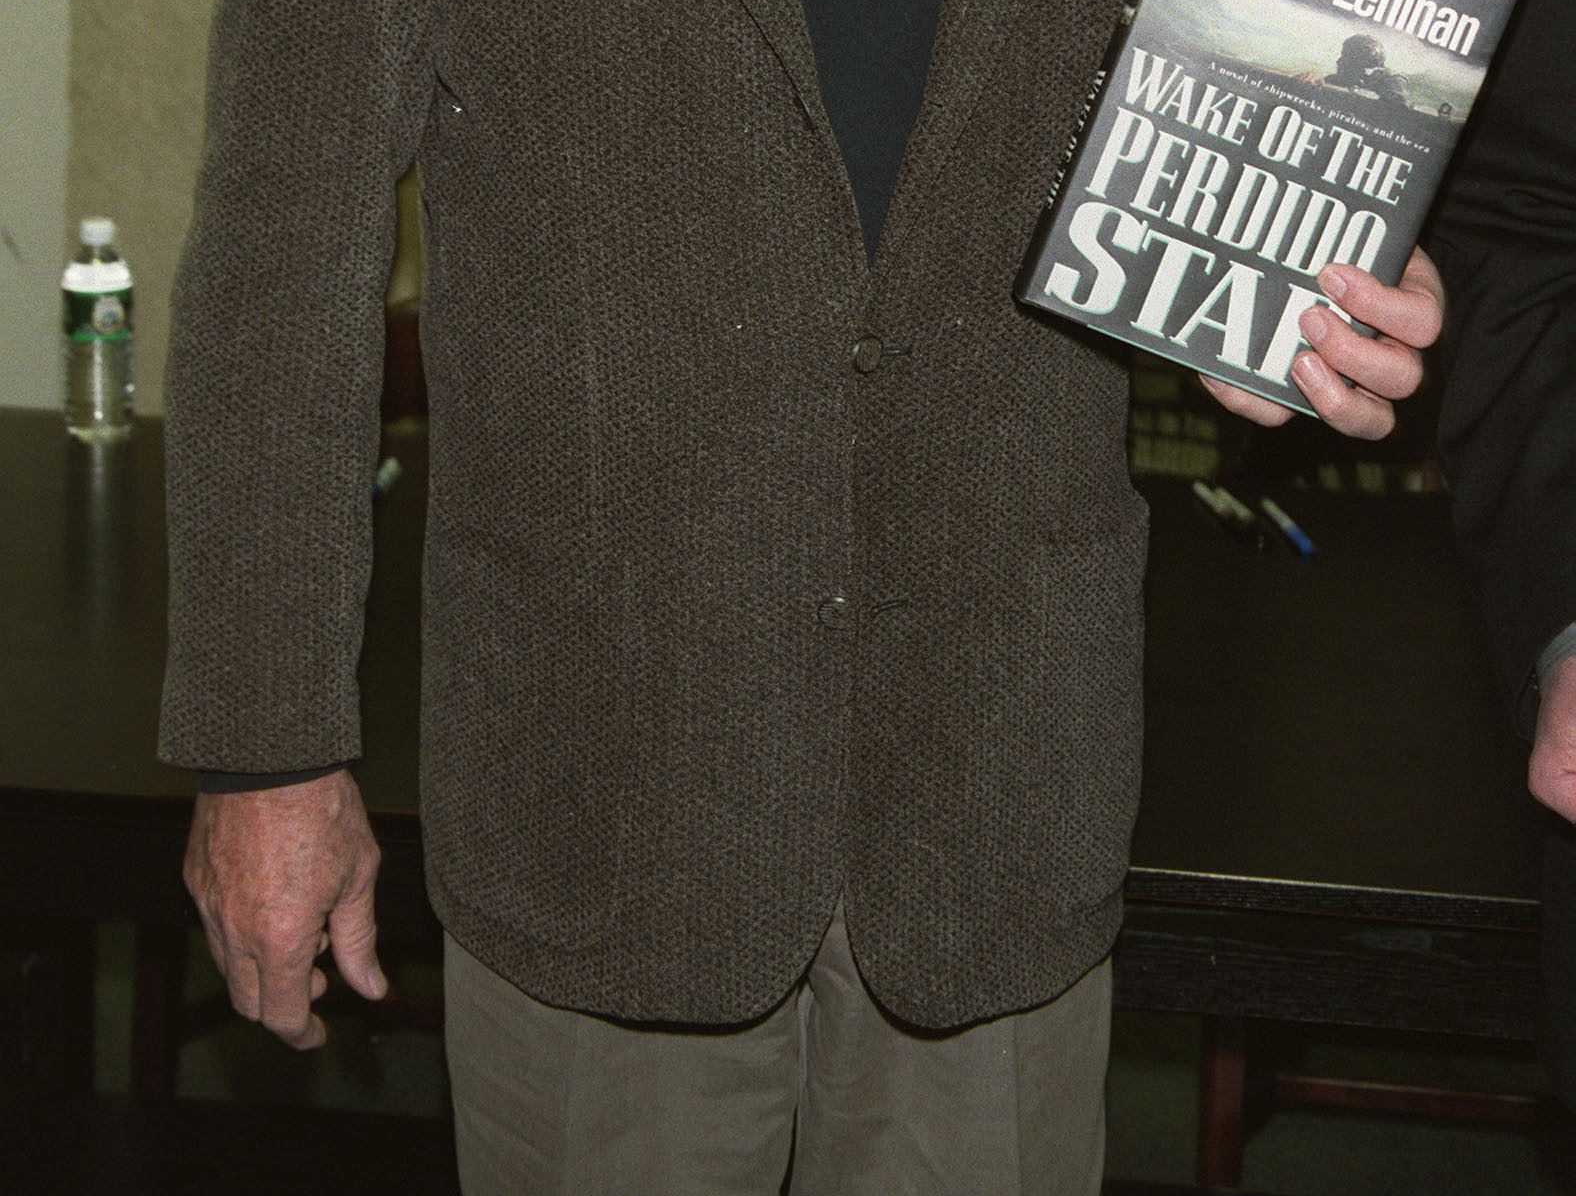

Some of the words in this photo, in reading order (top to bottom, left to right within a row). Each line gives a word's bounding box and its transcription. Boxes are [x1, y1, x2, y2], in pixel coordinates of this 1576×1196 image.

[1124, 46, 1258, 146] WAKE
[1257, 104, 1324, 168] OF
[1321, 125, 1413, 206] THE
[1209, 61, 1216, 71] A
[1219, 67, 1248, 85] novel
[1250, 78, 1262, 89] of
[1264, 83, 1325, 114] shipwrecks,
[1373, 125, 1394, 140] and
[1395, 133, 1412, 148] the
[1413, 142, 1431, 154] sea
[1085, 106, 1387, 277] PERDIDO
